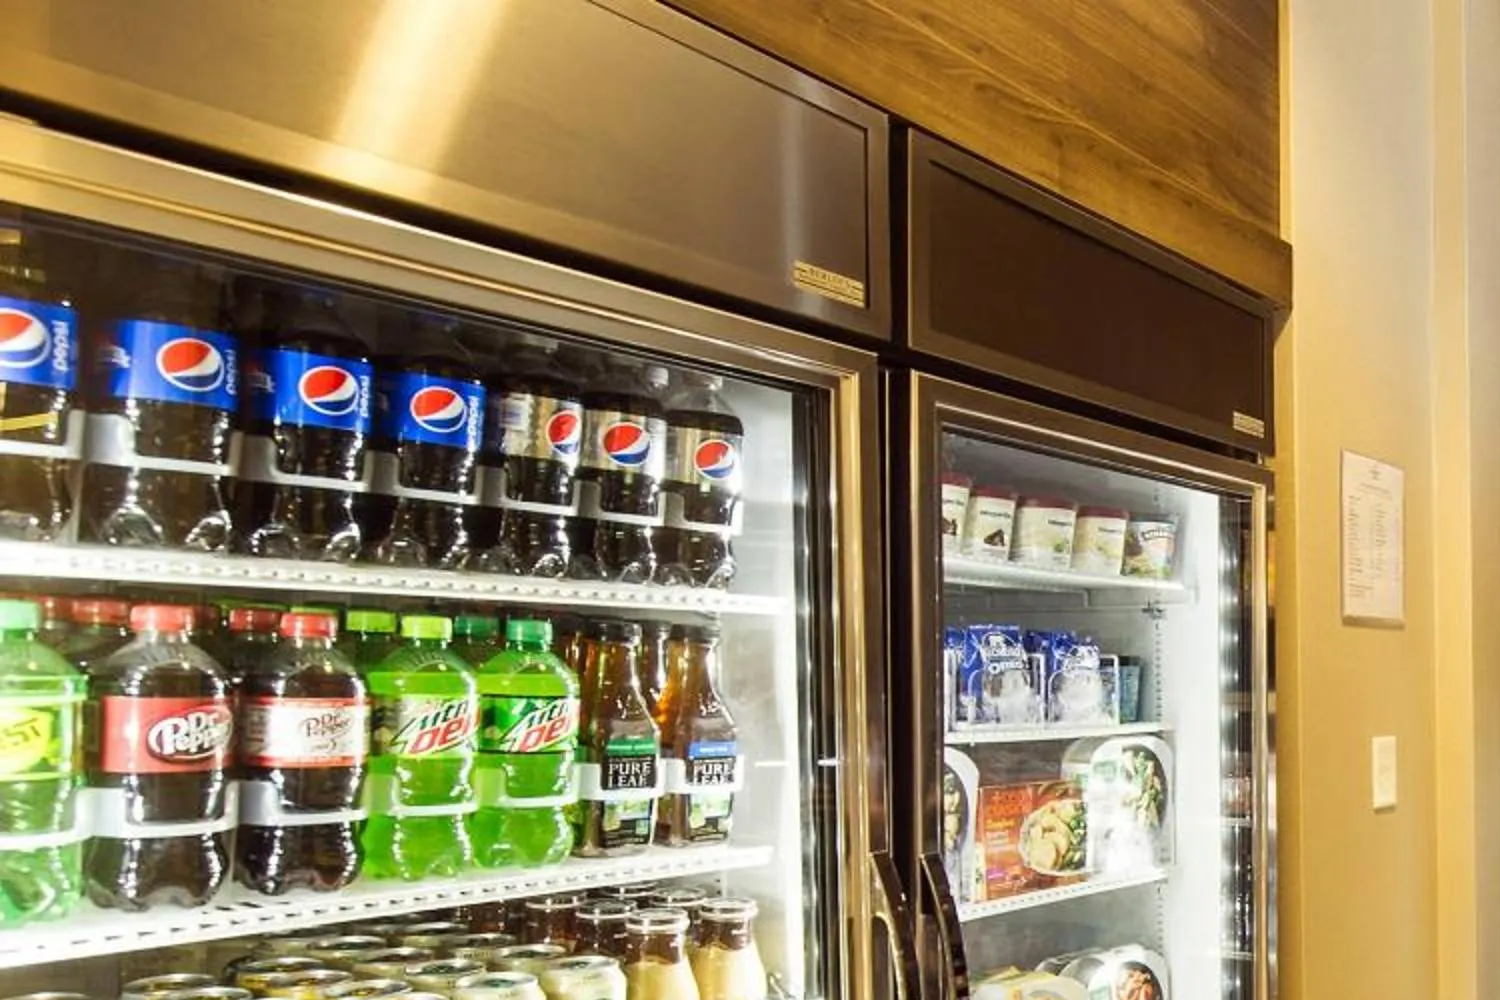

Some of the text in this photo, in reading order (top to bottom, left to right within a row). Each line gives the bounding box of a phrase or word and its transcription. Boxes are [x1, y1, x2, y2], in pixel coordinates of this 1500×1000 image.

[52, 320, 69, 372] pepsi
[224, 349, 237, 395] pepsi
[360, 375, 370, 418] pepsi
[467, 395, 480, 436] pepsi
[608, 761, 652, 775] PURE
[608, 775, 648, 789] LEAF
[694, 763, 732, 775] PURE
